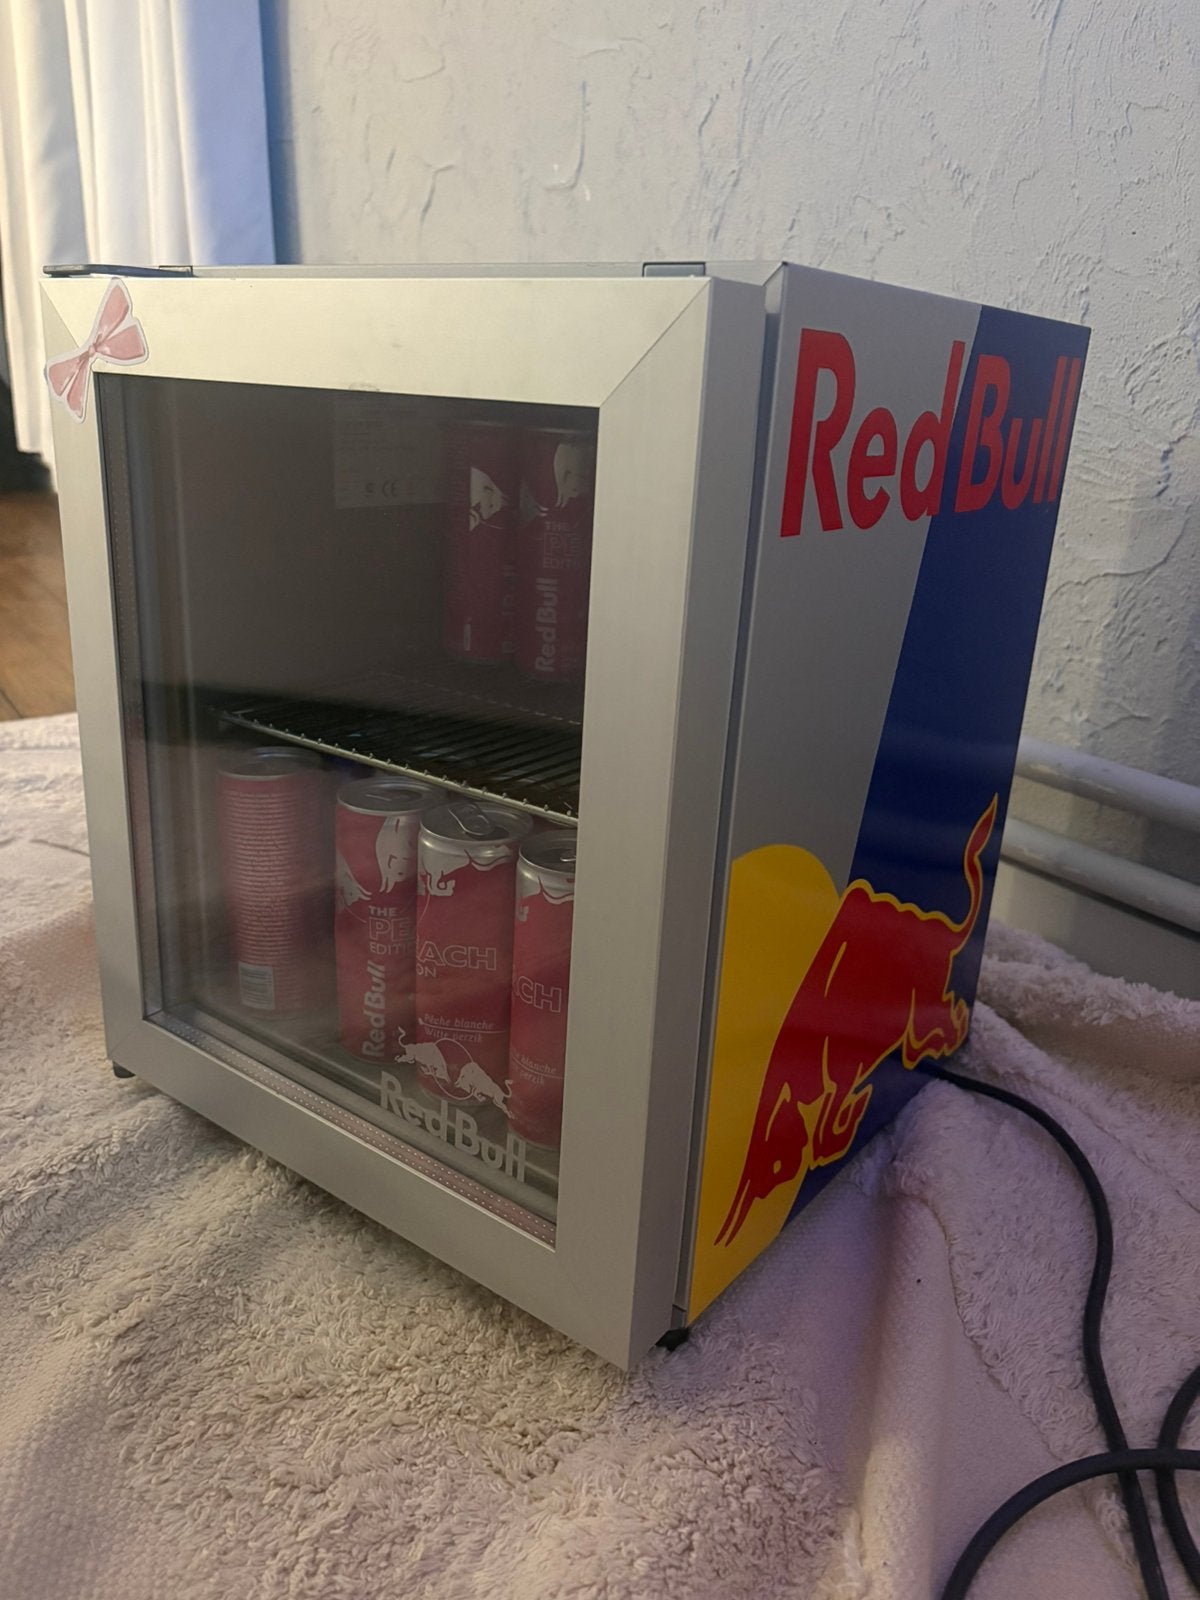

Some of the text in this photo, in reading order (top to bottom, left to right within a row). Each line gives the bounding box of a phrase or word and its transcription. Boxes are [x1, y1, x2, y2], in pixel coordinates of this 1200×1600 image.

[780, 328, 1081, 537] Red Bull
[543, 532, 584, 557] PE
[534, 577, 559, 673] Red Bull
[368, 905, 398, 917] THE
[369, 916, 416, 942] PE
[417, 940, 497, 972] ACH
[361, 960, 387, 1058] Red Bull
[515, 975, 562, 1014] CH
[454, 1017, 495, 1031] blanche
[380, 1070, 527, 1184] Red Bull
